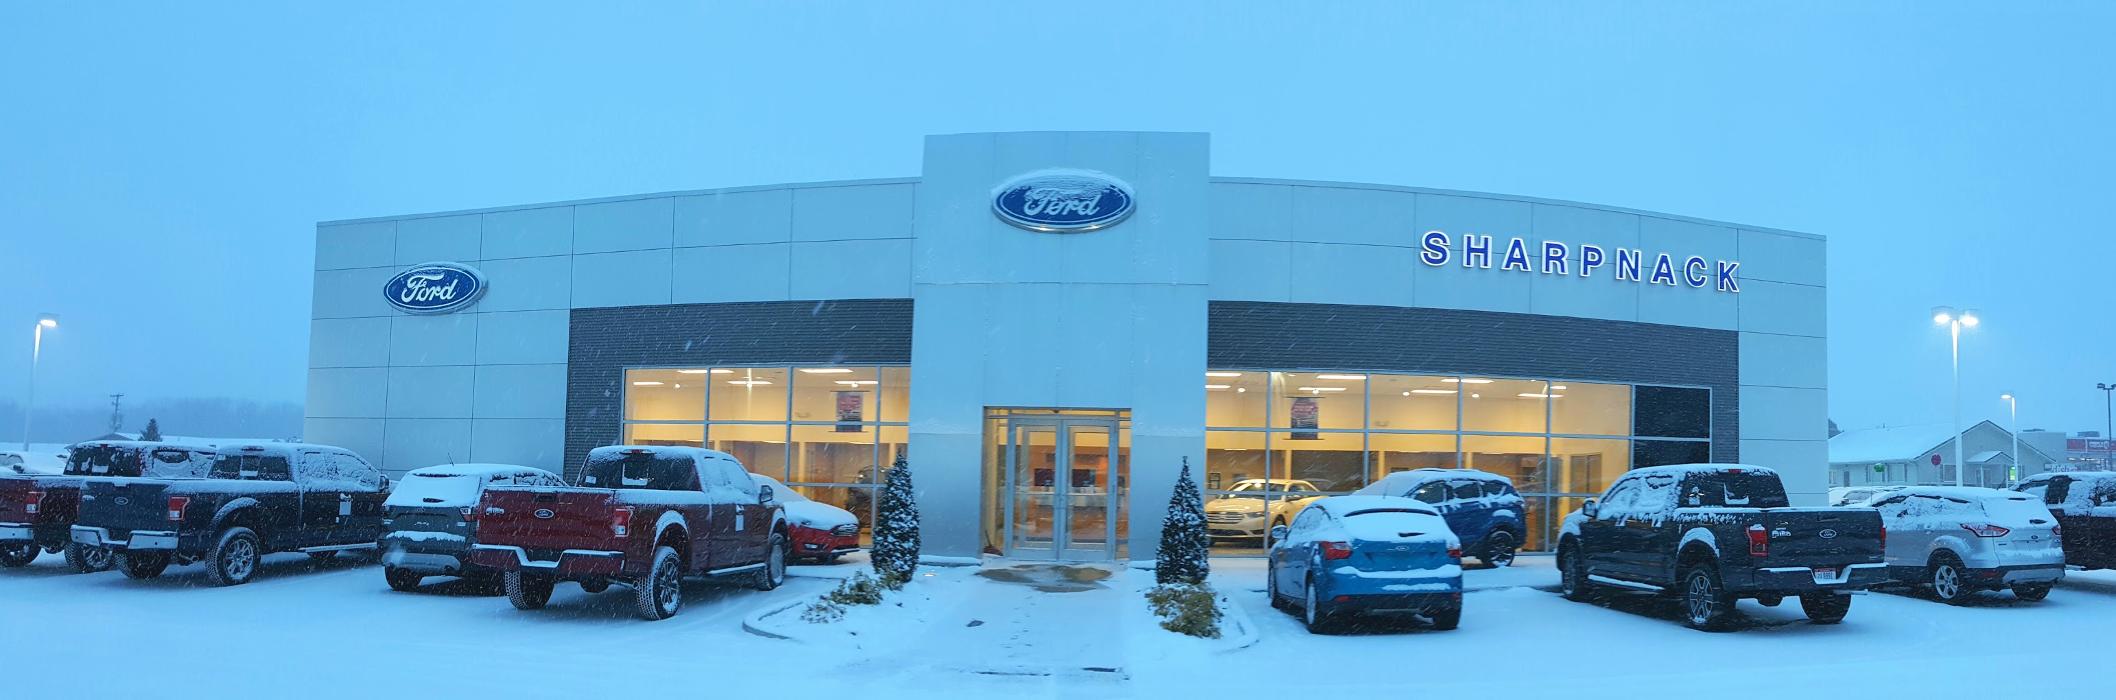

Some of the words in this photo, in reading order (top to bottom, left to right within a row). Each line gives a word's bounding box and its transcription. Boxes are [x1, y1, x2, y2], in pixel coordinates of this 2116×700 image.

[1024, 188, 1102, 216] Ford
[1420, 230, 1740, 293] SHARPNACK
[401, 273, 459, 303] Ford
